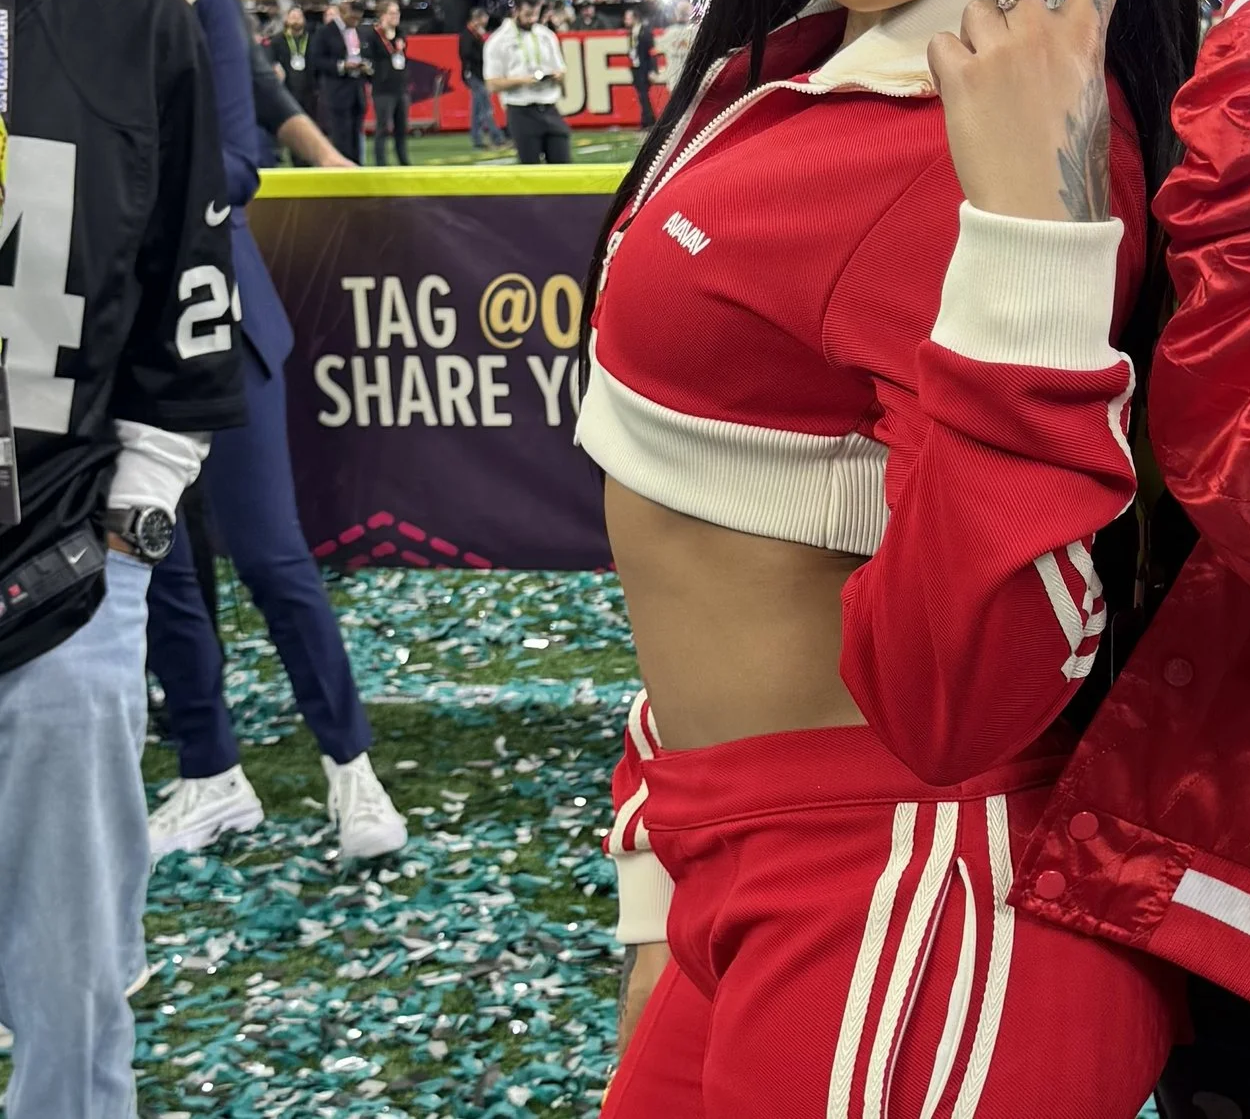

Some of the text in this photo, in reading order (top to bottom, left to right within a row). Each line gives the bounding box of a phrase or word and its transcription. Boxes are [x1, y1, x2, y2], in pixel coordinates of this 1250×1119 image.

[661, 210, 711, 256] AVAVAV
[176, 264, 243, 360] 2
[341, 274, 457, 349] TAG
[314, 354, 581, 428] SHARE Y
